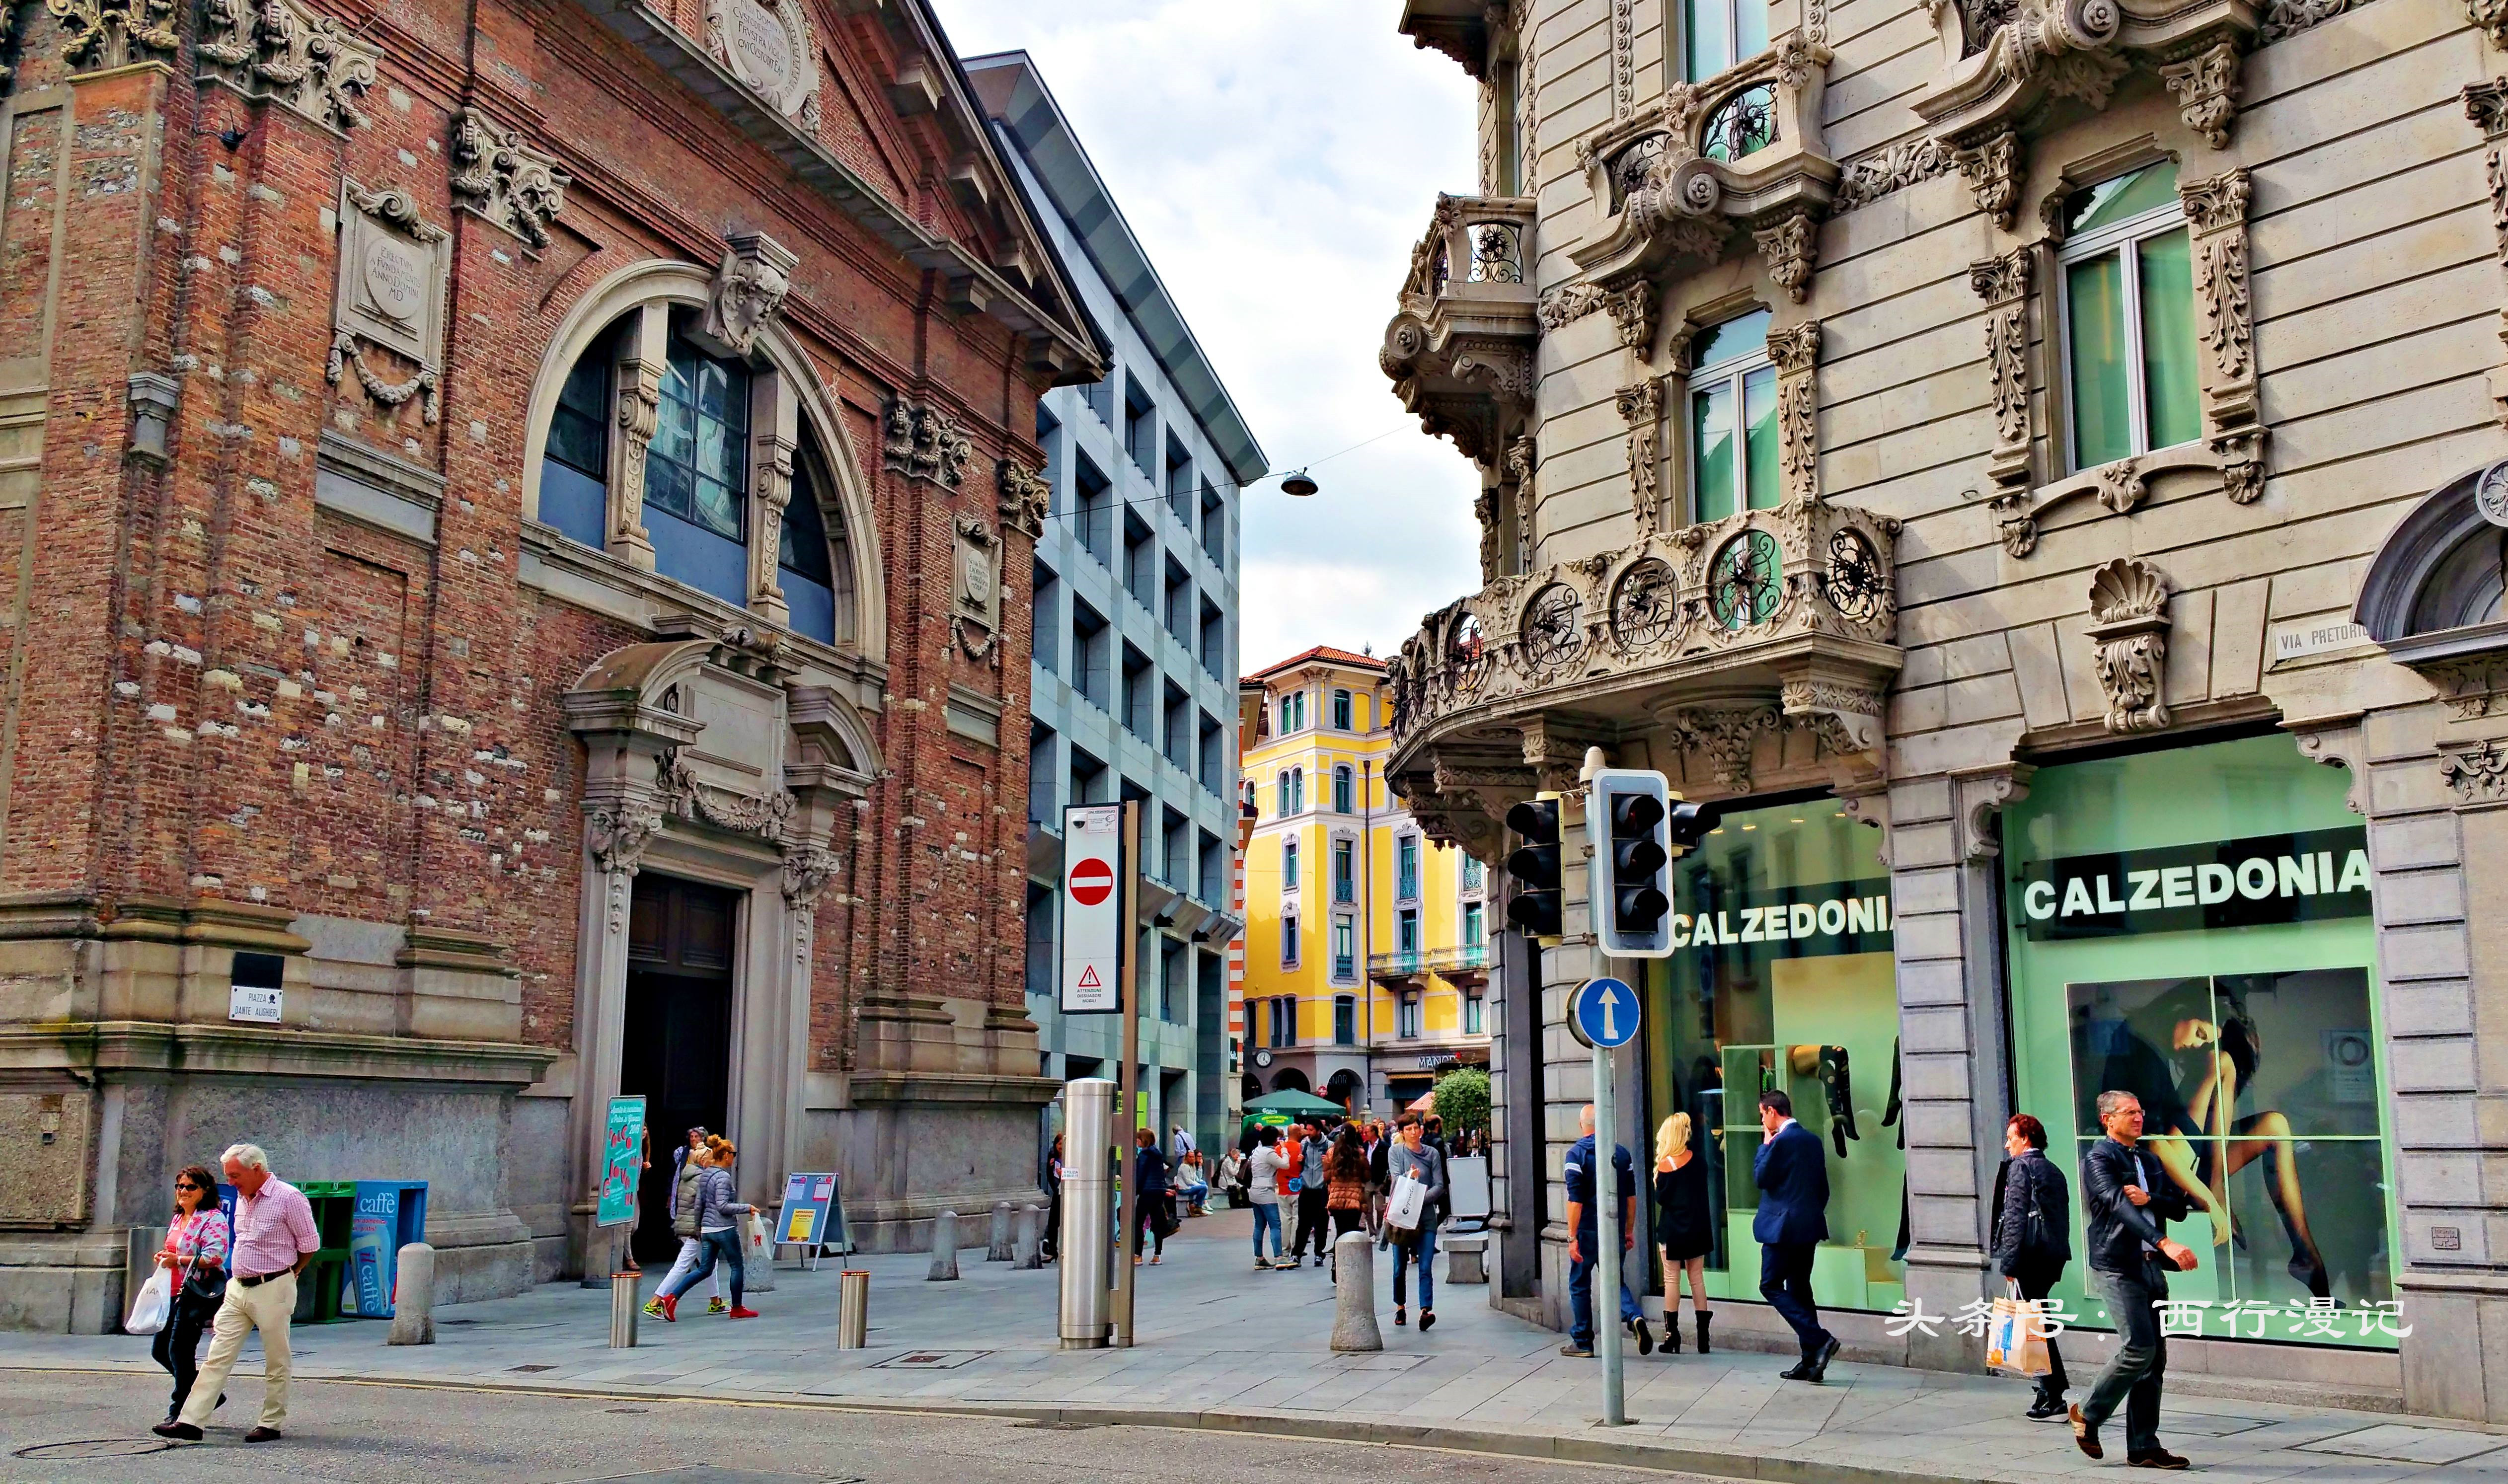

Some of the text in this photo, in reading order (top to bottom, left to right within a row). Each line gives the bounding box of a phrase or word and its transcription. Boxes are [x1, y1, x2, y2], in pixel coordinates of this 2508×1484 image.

[372, 267, 418, 298] ANNO DOMINI
[2281, 633, 2302, 650] VIA
[2024, 849, 2372, 920] CALZEDONIA
[1673, 895, 1895, 948] CALZEDONI
[248, 993, 266, 1003] PIAZZA
[234, 1006, 278, 1017] DANTE ALIGHIERI
[360, 1192, 395, 1213] caffè
[362, 1265, 380, 1312] caffè
